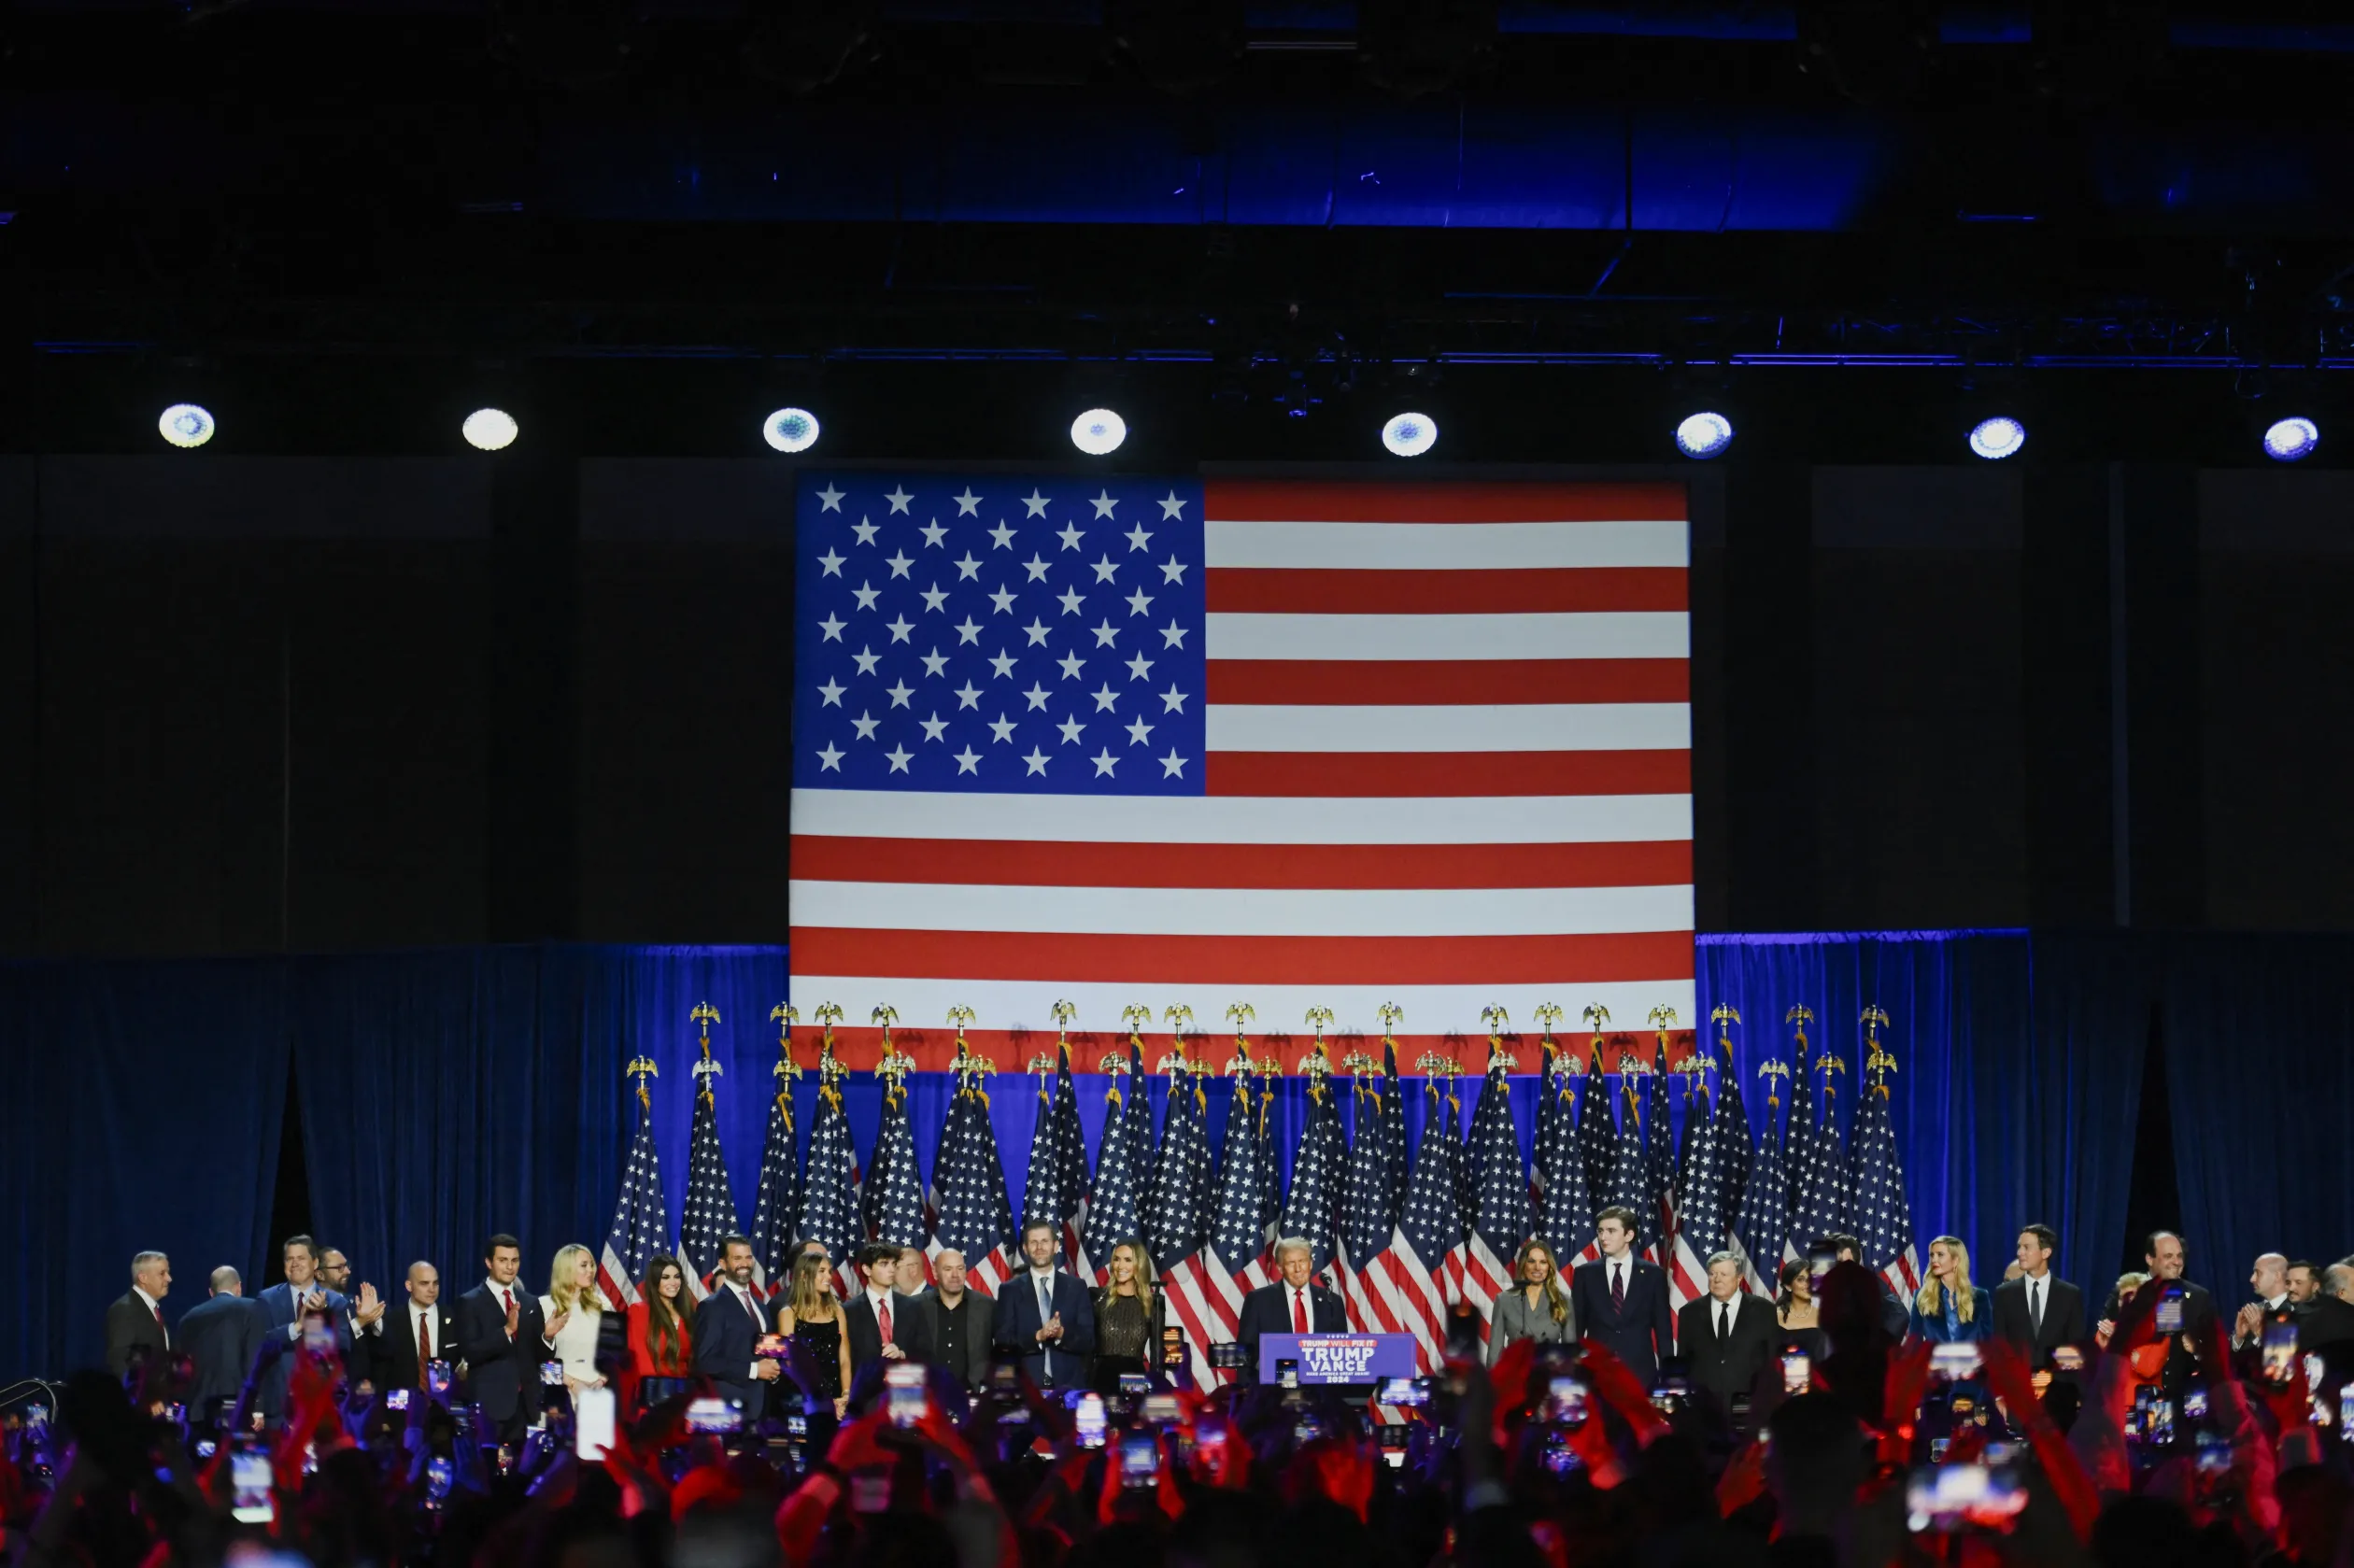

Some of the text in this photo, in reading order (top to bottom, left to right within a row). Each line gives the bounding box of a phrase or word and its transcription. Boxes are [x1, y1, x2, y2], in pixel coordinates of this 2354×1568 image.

[1301, 1339, 1374, 1348] TRUMP WILL FIX IT
[1301, 1348, 1375, 1362] TRUMP
[1310, 1361, 1367, 1372] VANCE
[1326, 1376, 1350, 1384] 2024
